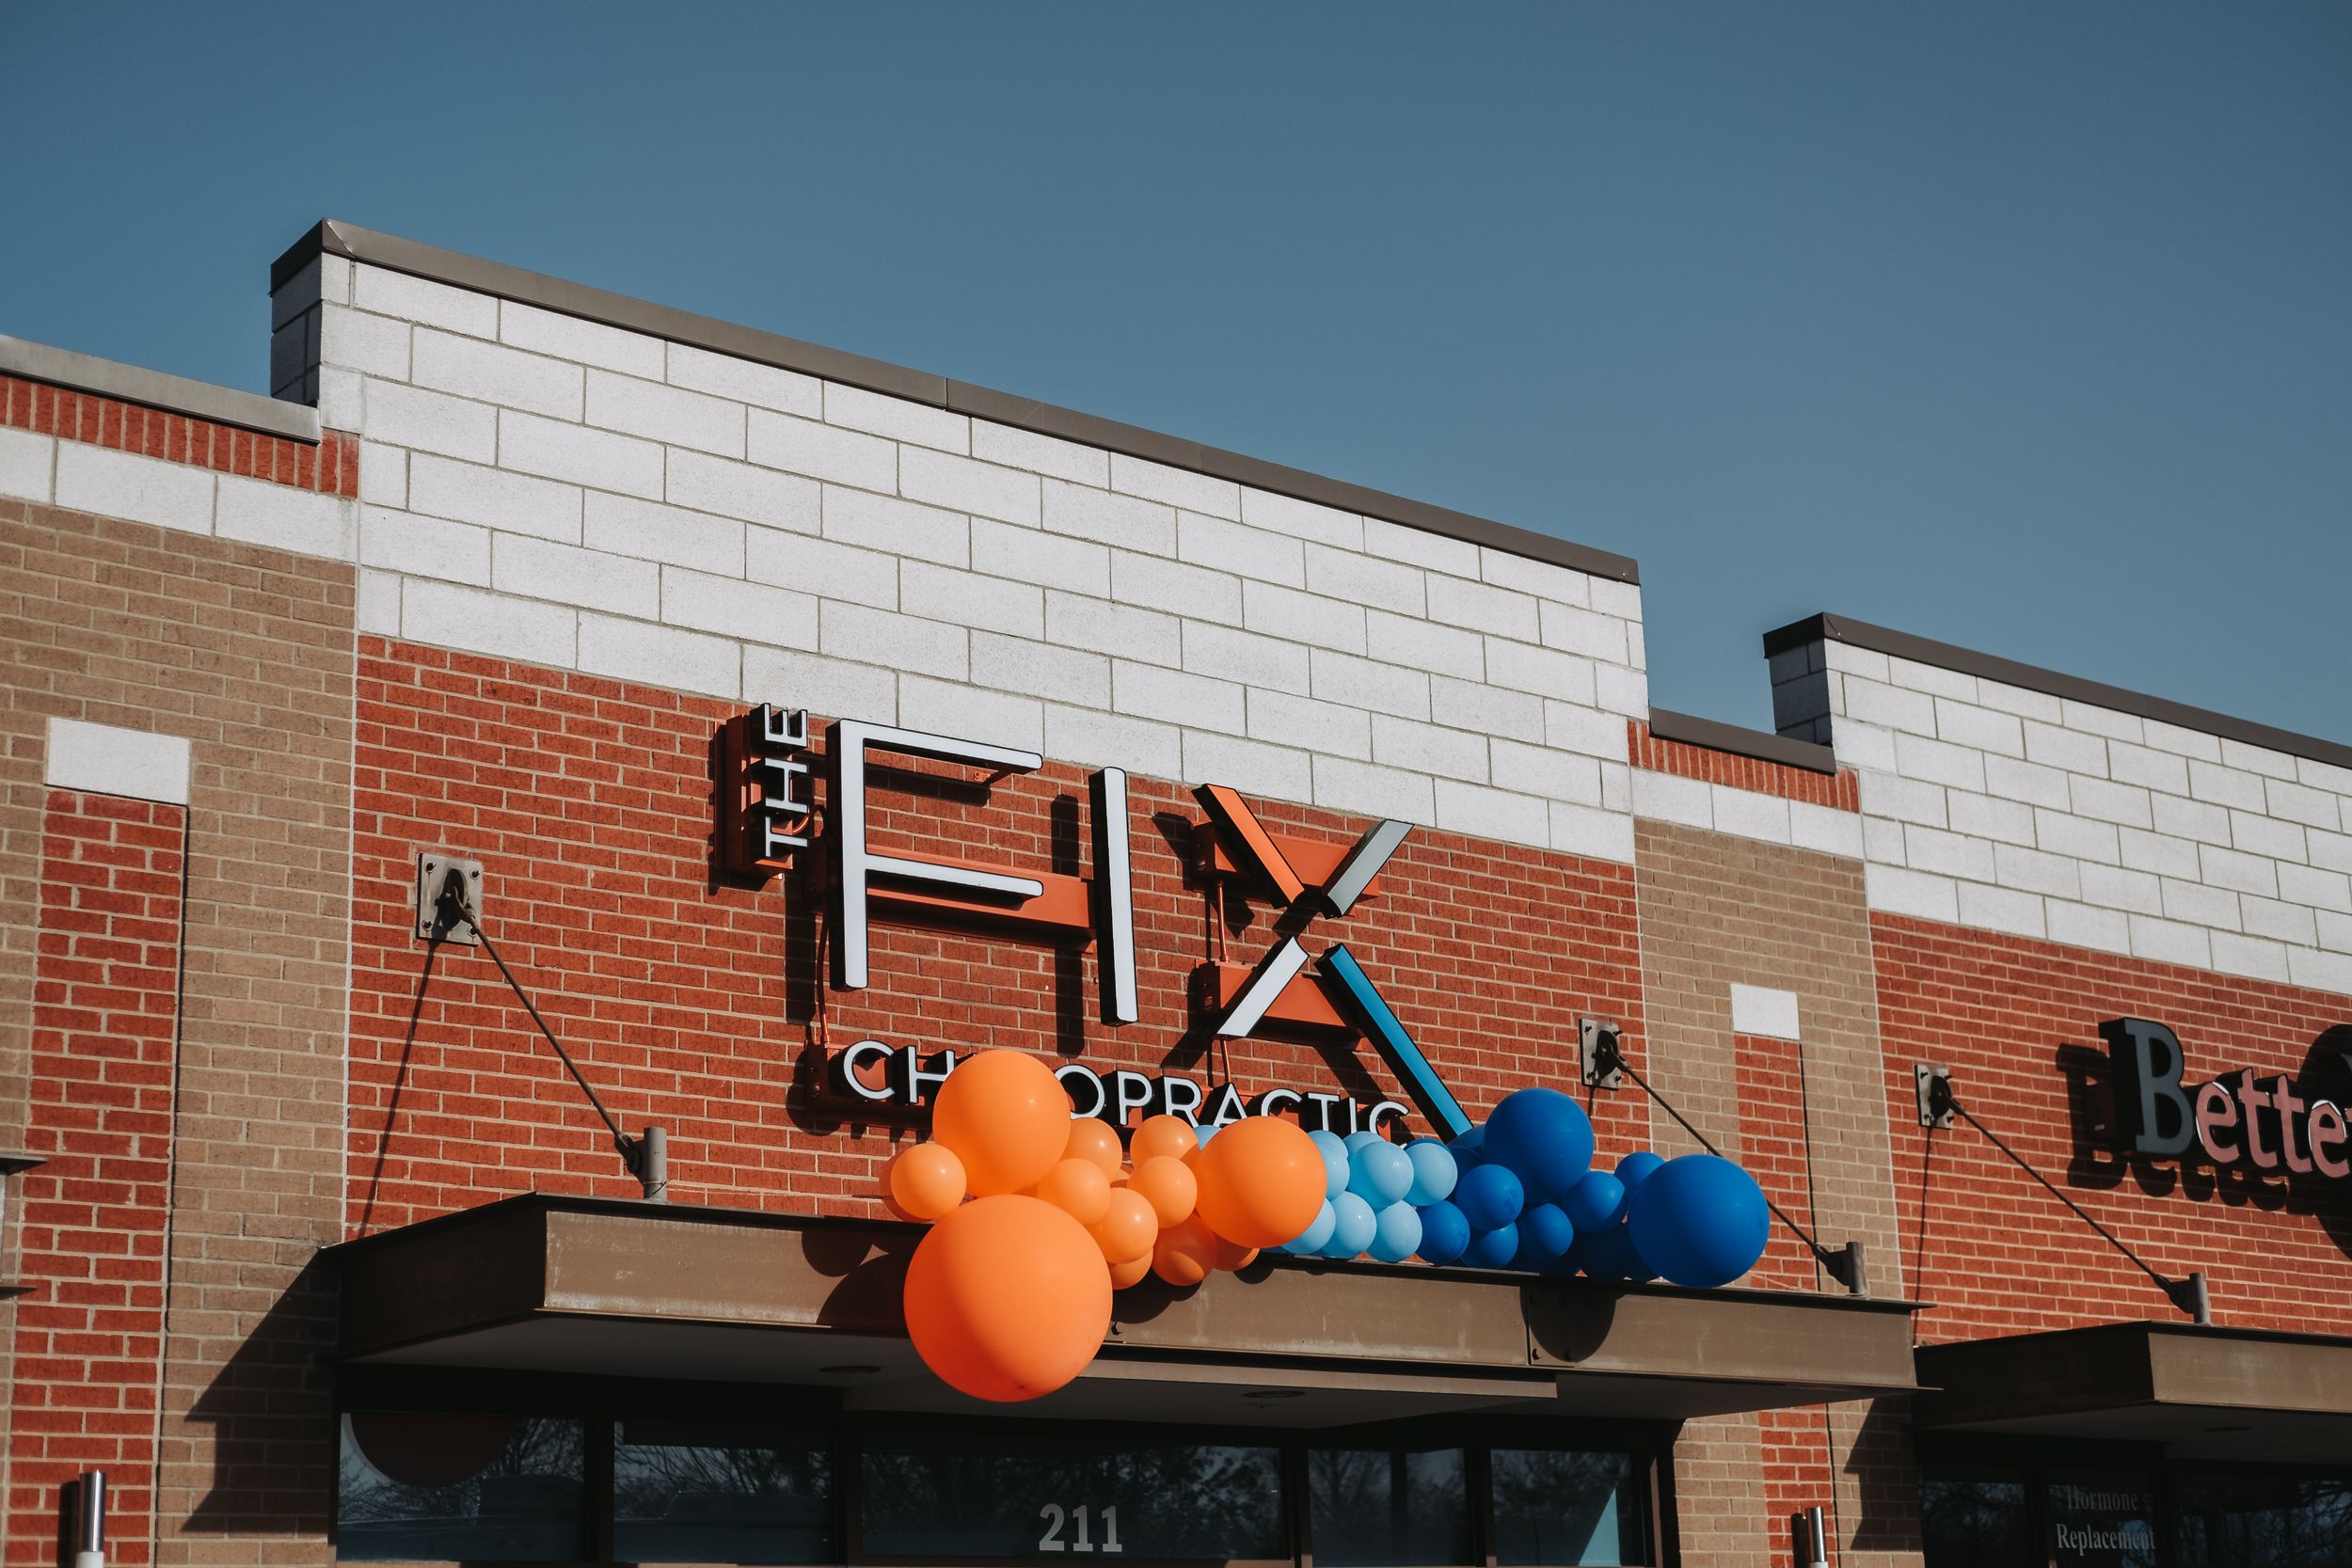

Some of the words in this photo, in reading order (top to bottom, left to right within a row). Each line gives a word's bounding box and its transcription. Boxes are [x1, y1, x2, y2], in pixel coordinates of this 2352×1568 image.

[763, 702, 809, 859] THE
[835, 719, 1471, 1139] FIX
[843, 1039, 1409, 1148] CHOPRACTIC
[2122, 1017, 2352, 1178] Bette
[1039, 1504, 1122, 1552] 211
[2056, 1523, 2155, 1557] Replacement
[2063, 1484, 2138, 1512] Hormone
